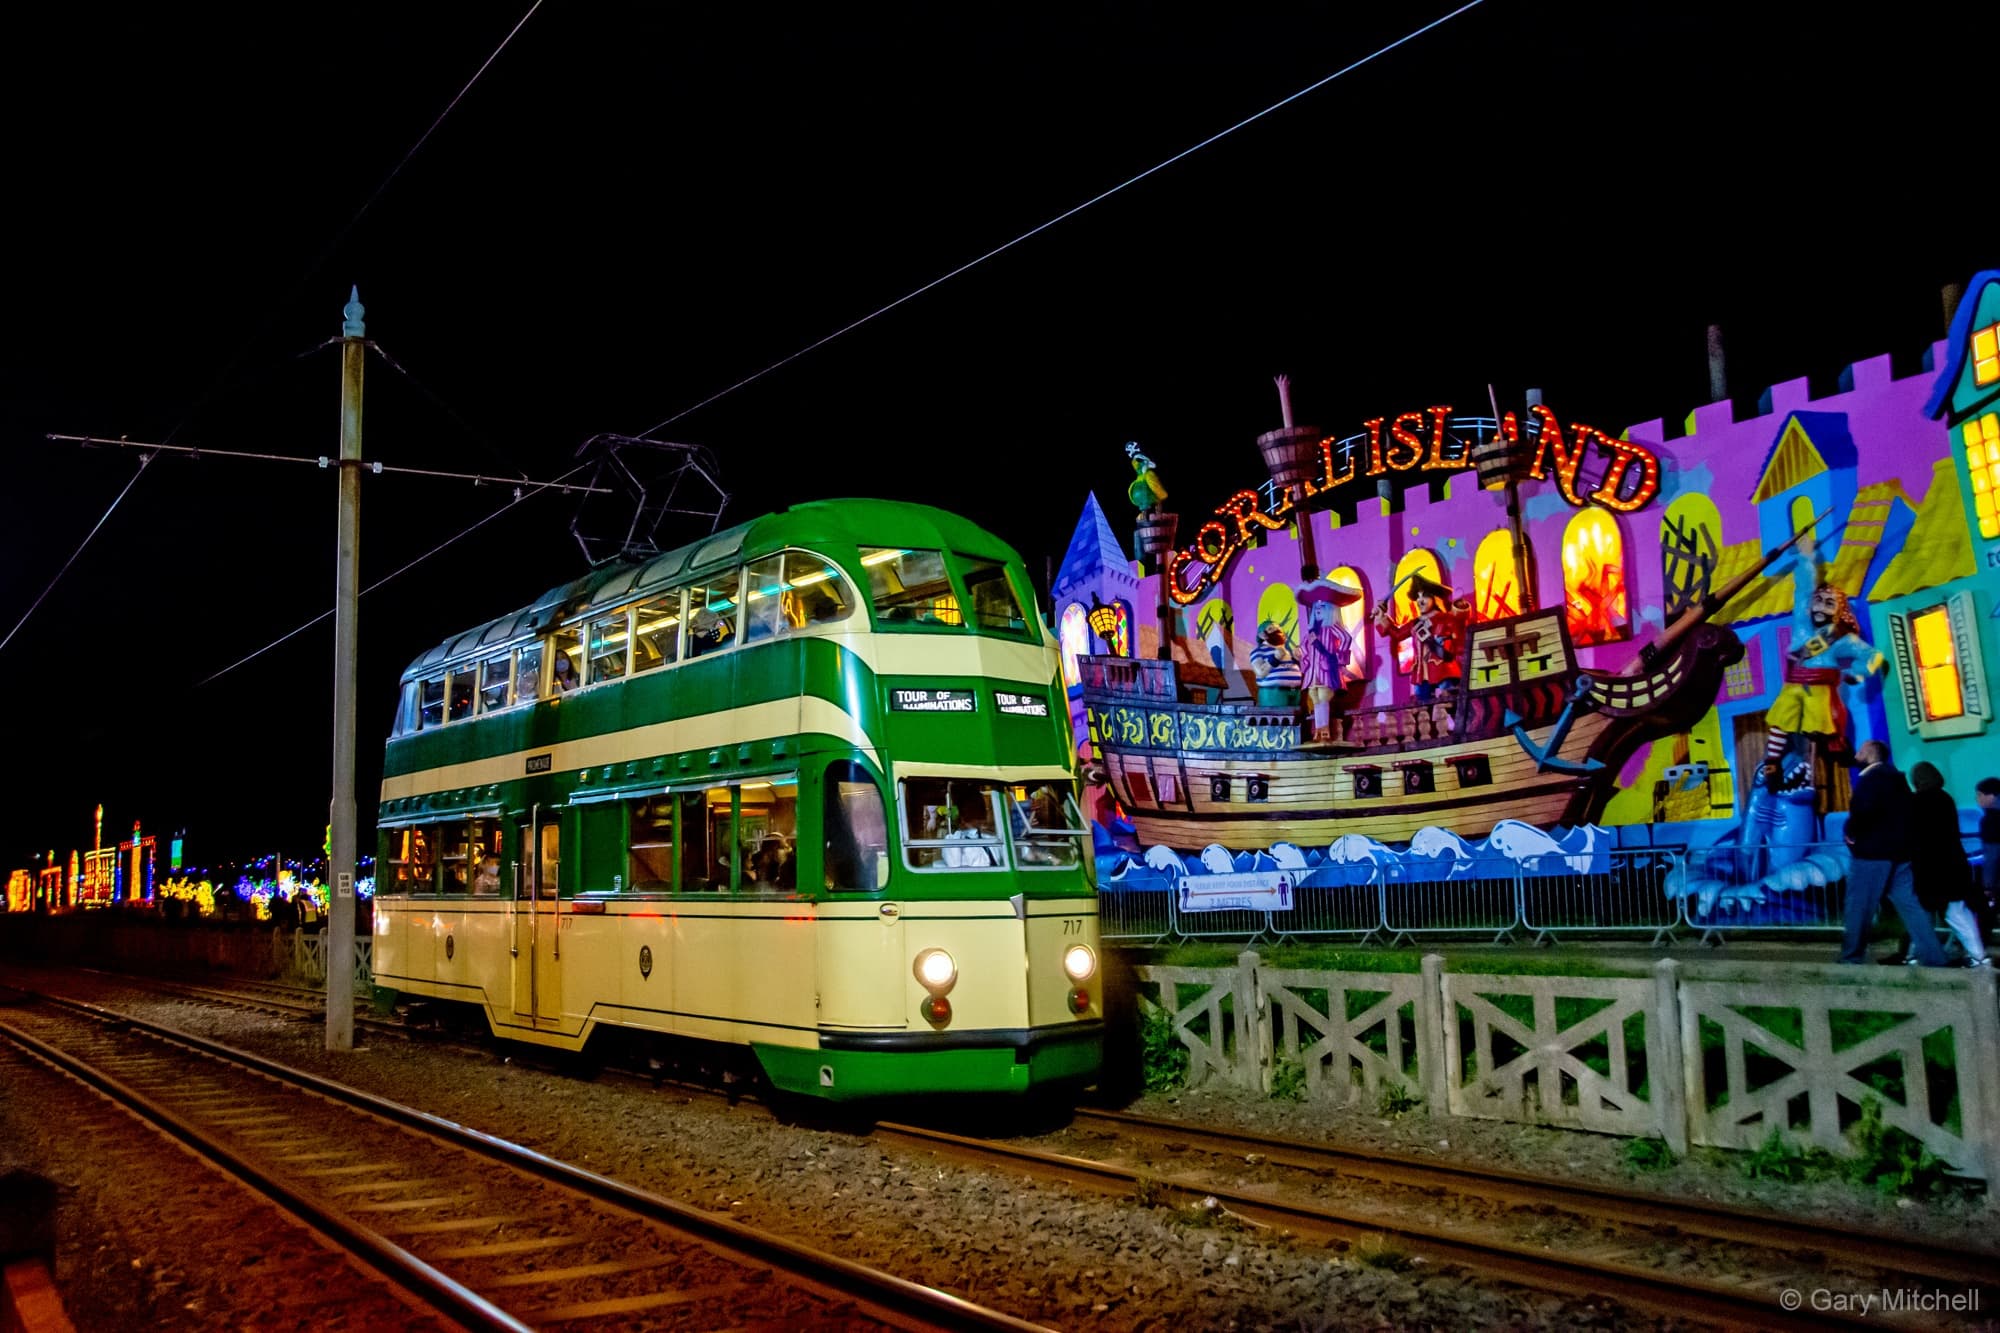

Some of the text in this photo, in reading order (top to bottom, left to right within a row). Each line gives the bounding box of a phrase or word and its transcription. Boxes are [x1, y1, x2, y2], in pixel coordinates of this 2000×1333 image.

[896, 690, 951, 703] TOUR OF
[995, 692, 1032, 705] TOUR OF
[902, 698, 972, 711] ILLUMINATIONS
[562, 917, 573, 929] 717
[1063, 919, 1083, 935] 717
